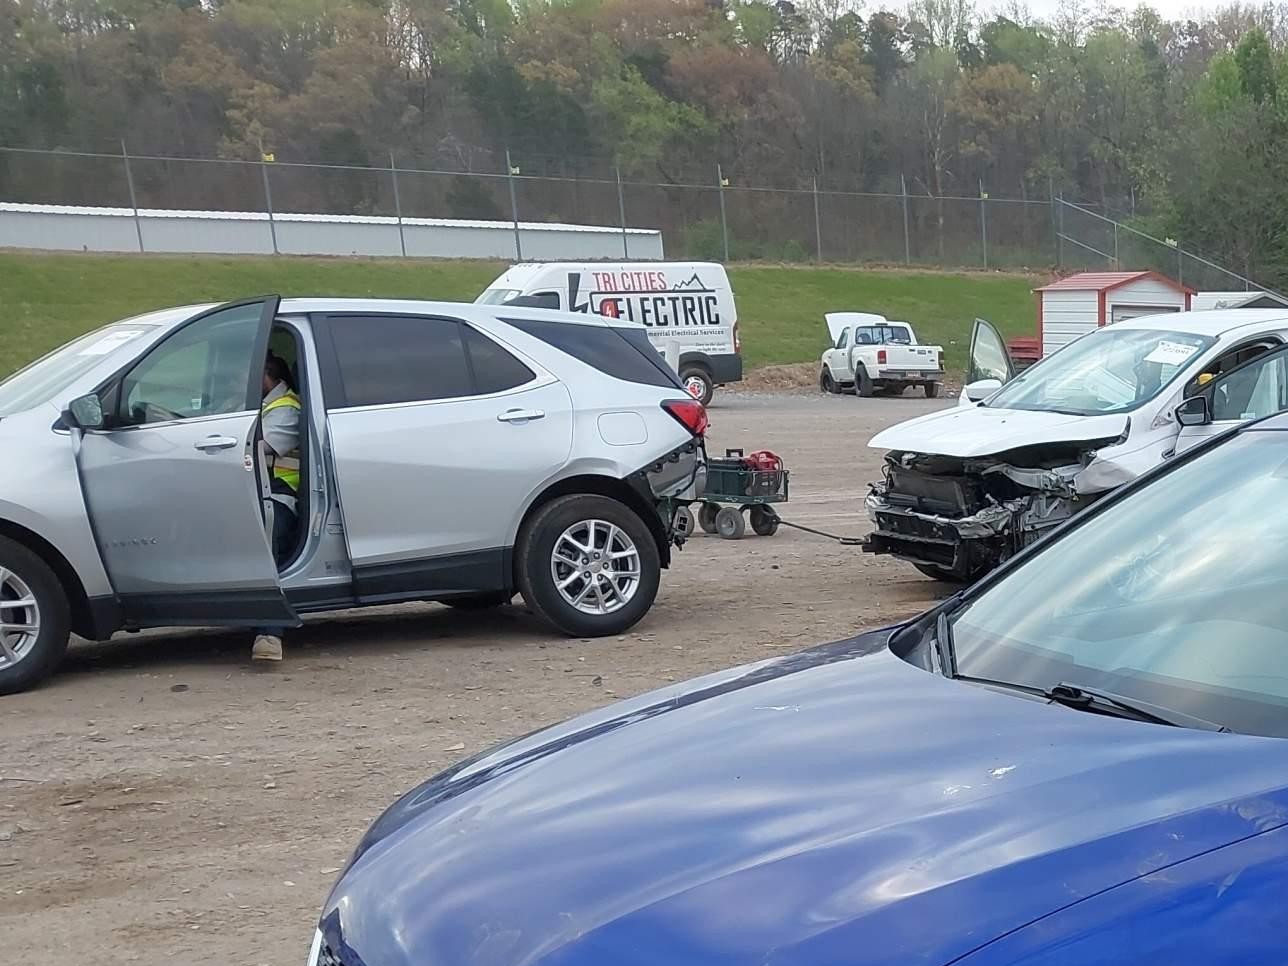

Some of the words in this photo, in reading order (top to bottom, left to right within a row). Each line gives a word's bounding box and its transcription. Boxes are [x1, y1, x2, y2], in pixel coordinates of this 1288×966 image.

[592, 272, 618, 291] TRI
[621, 271, 667, 290] CITIES
[614, 295, 720, 327] ELECTRIC
